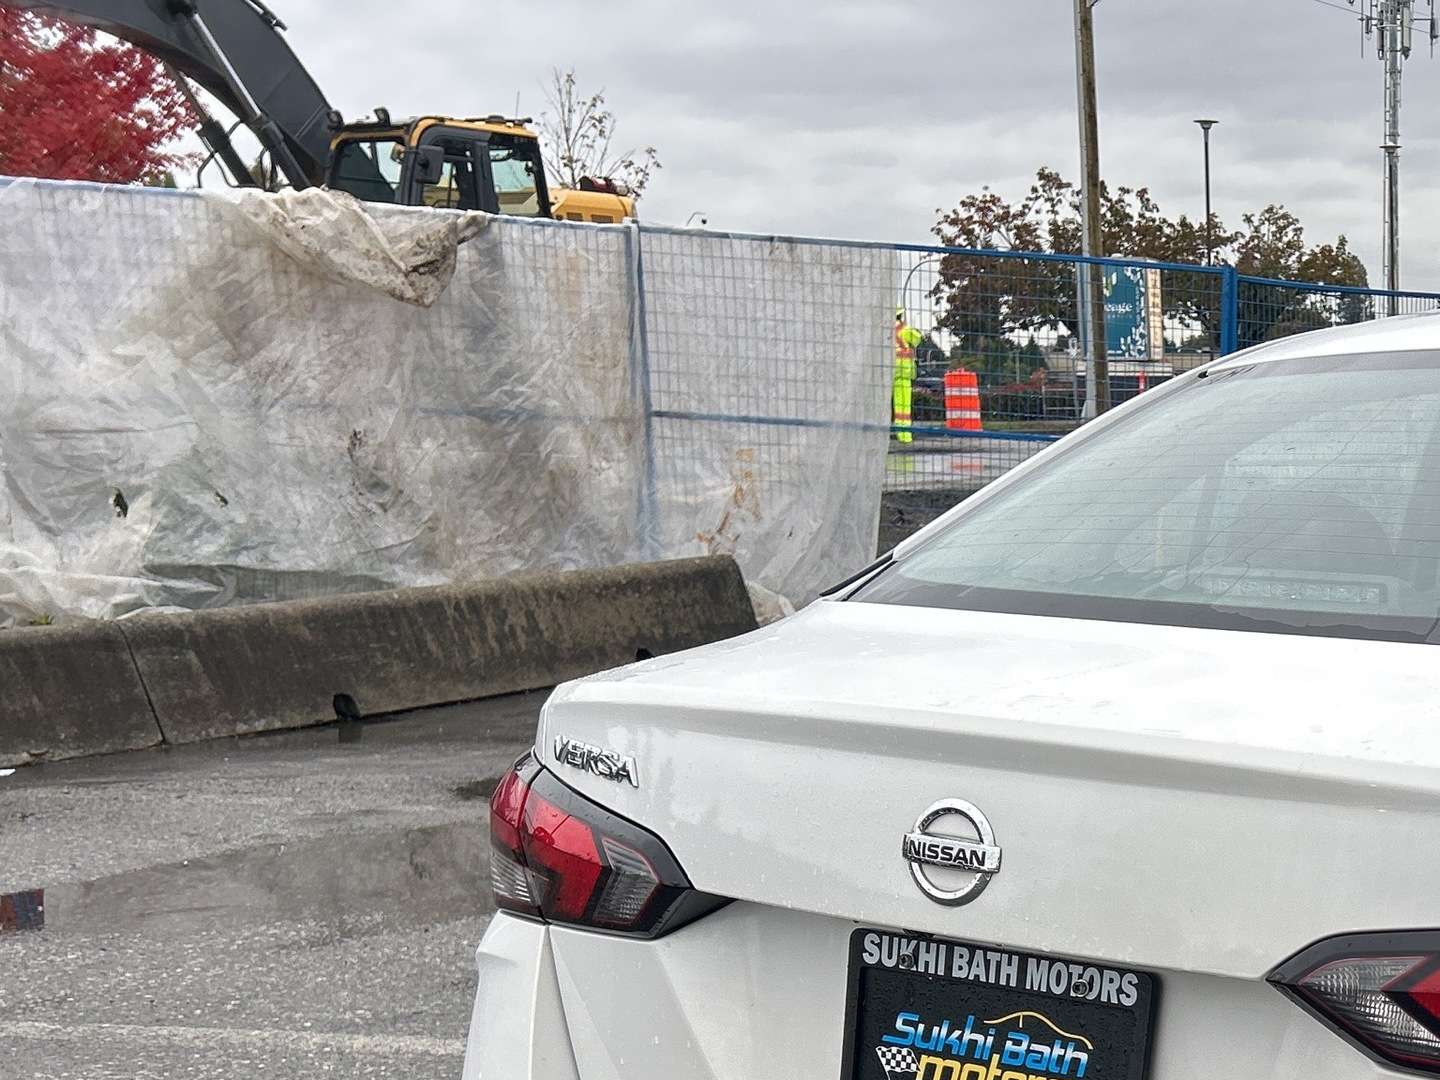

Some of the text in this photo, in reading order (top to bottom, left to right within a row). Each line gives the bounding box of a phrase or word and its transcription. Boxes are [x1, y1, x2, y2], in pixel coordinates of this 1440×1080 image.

[554, 735, 639, 788] VERSA
[908, 839, 987, 867] NISSAN
[862, 933, 1138, 1007] SUKHI BATH MOTORS
[881, 1010, 1089, 1079] Sukhi Bath
